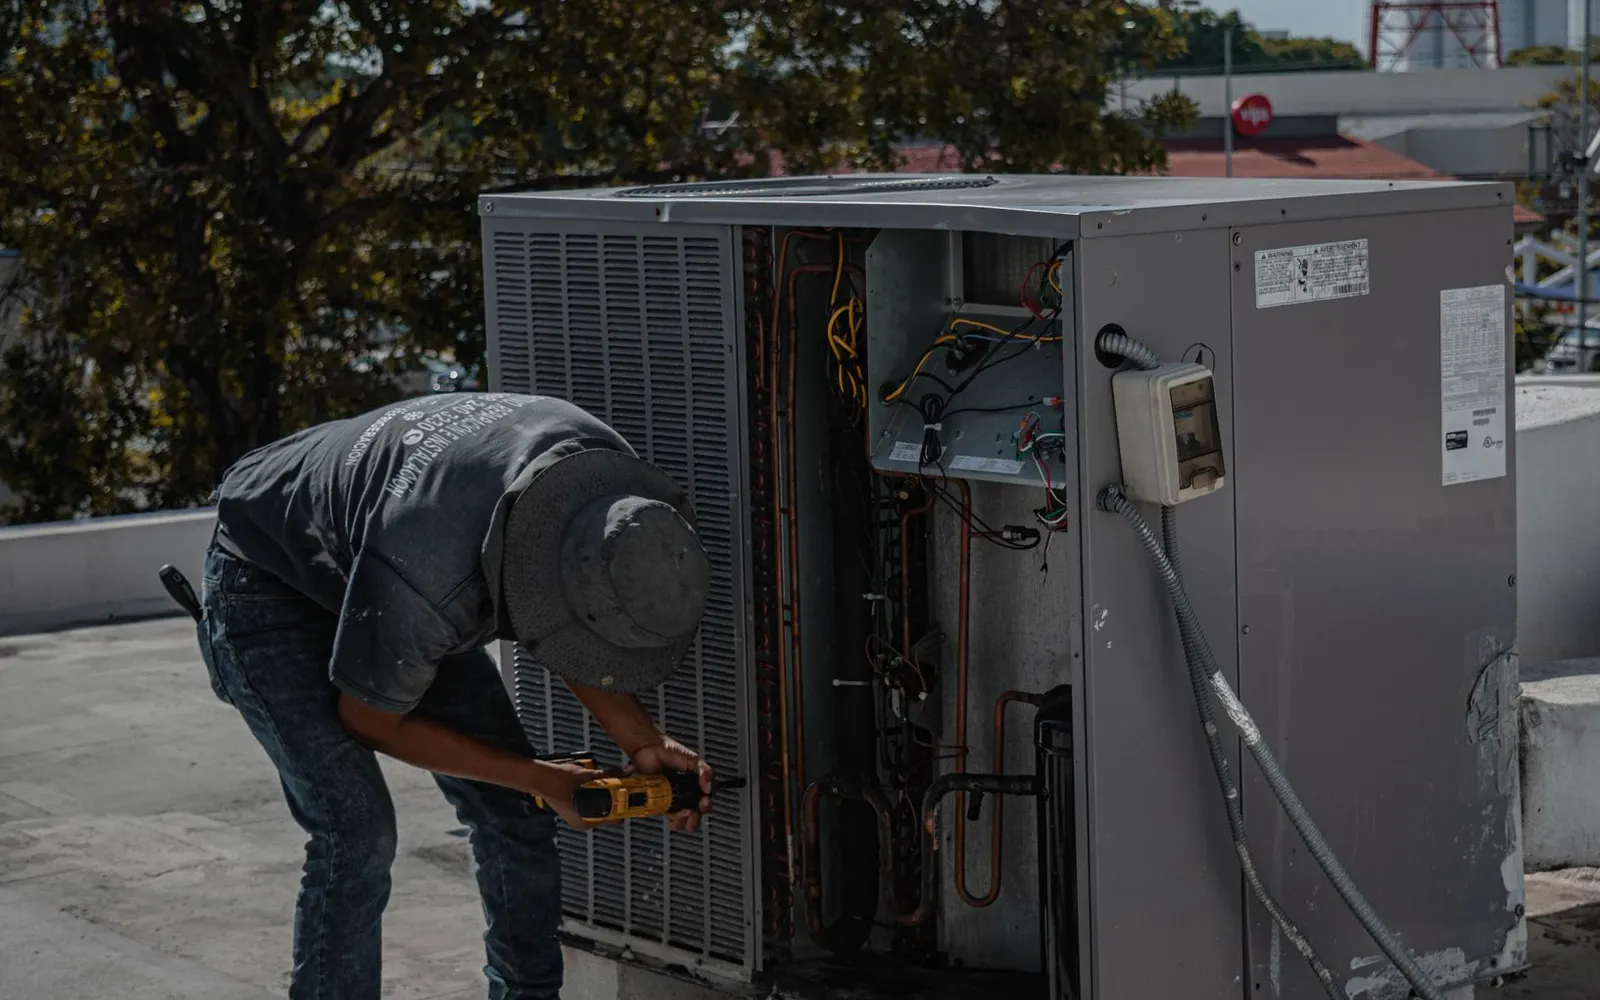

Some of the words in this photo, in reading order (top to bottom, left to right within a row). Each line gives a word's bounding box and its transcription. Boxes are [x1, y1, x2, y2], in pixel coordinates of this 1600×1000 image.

[1268, 250, 1293, 258] WARNING
[416, 410, 459, 432] 3230
[385, 432, 452, 498] INSTALACIÓN
